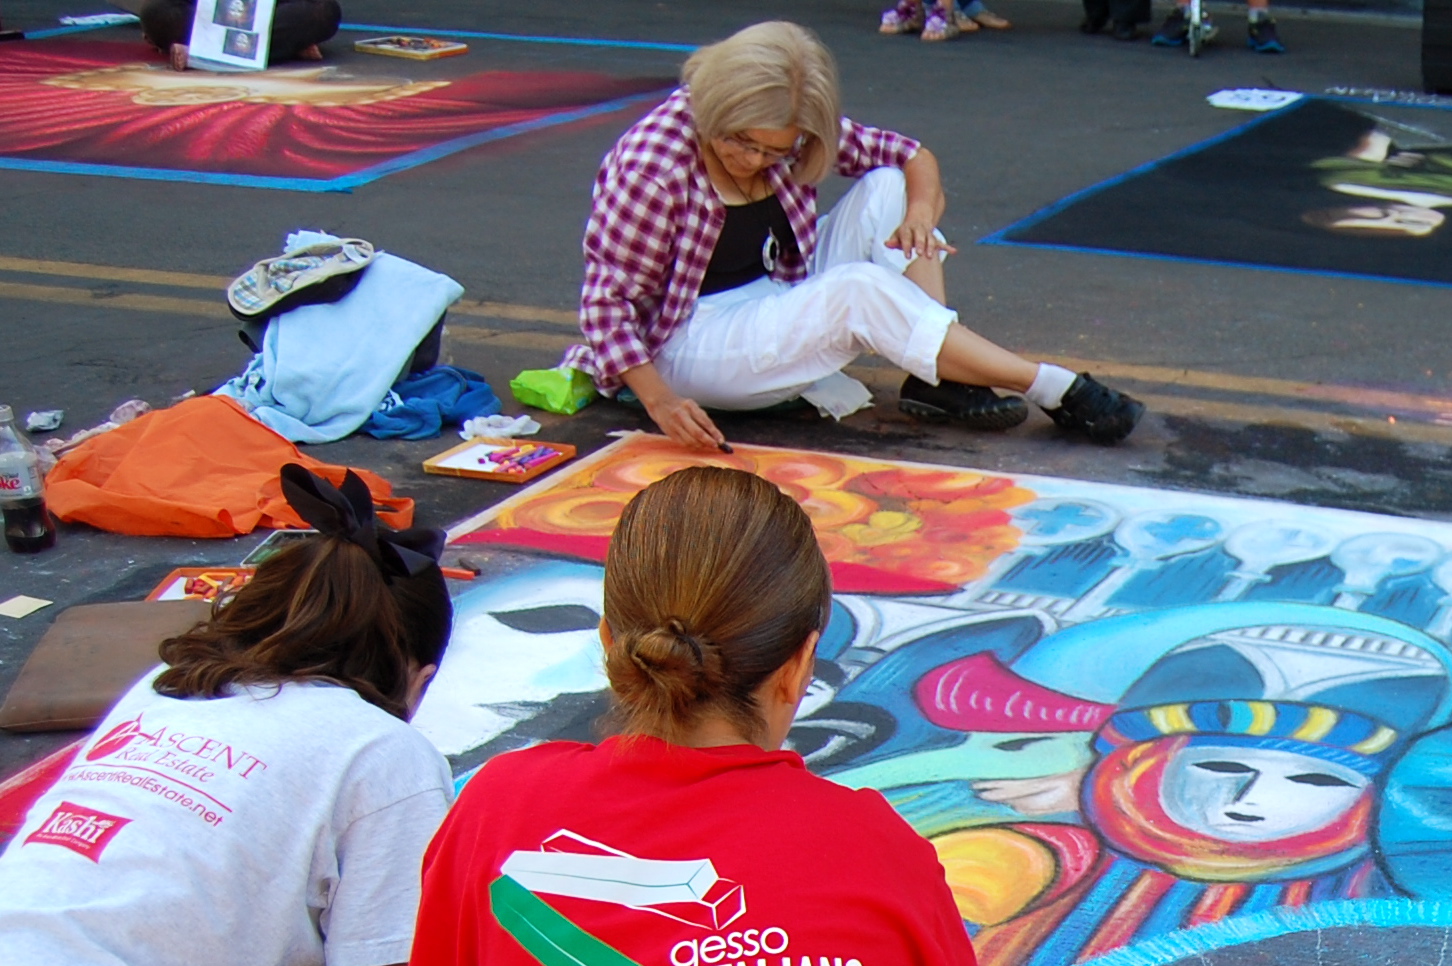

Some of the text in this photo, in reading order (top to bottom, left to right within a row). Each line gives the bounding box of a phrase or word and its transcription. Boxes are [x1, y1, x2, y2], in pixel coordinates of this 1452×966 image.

[115, 747, 215, 783] Real Estate
[134, 726, 268, 780] ASCENT
[42, 811, 106, 844] Kashi
